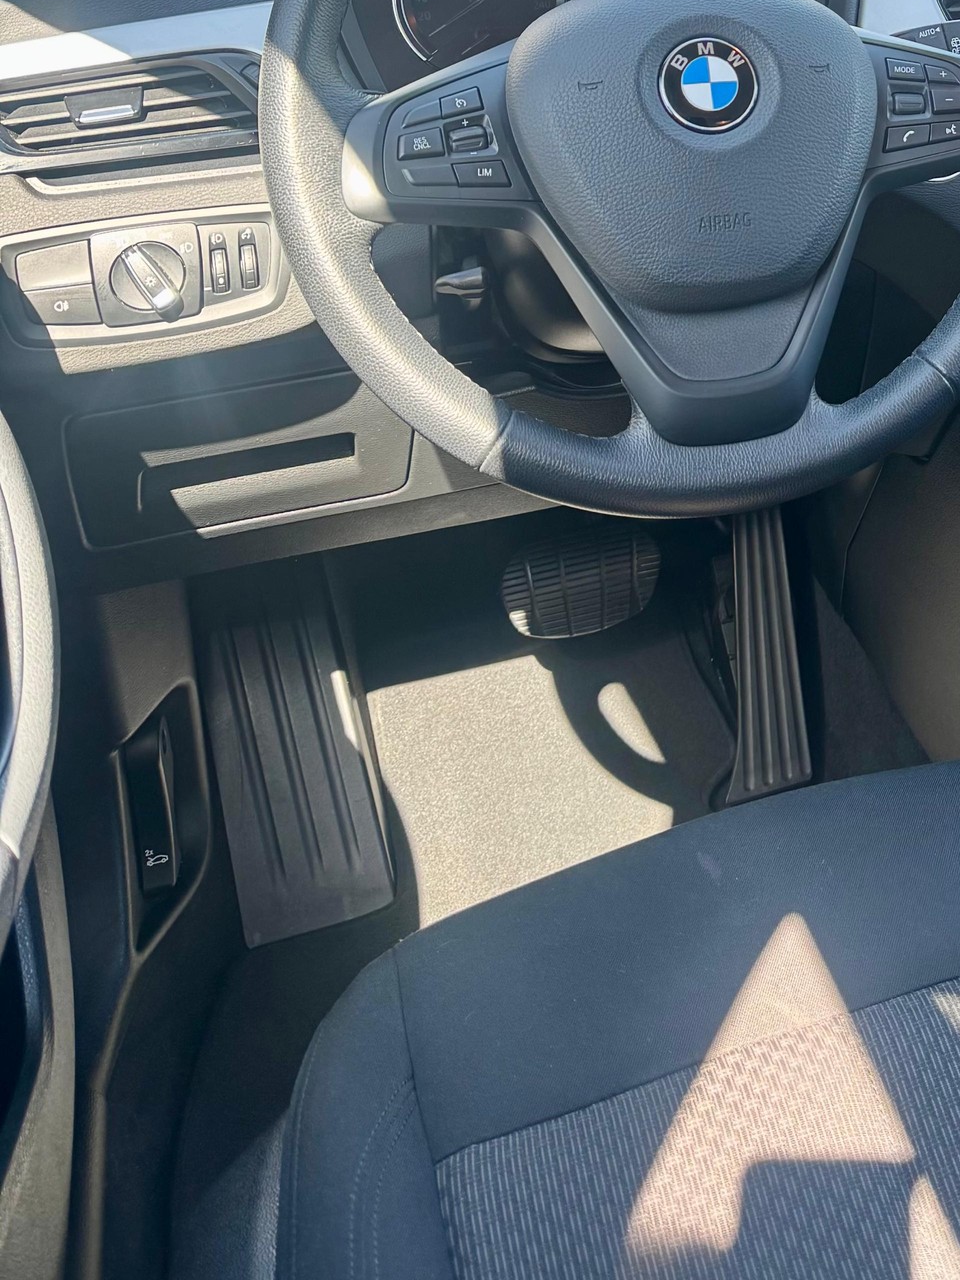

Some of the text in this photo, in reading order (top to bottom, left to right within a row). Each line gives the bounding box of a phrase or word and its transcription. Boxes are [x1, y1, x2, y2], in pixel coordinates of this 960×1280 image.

[919, 27, 936, 39] AUTO
[670, 42, 745, 71] BMW
[894, 65, 915, 74] MODE
[477, 168, 492, 177] LIM
[698, 212, 752, 233] AIRBAG
